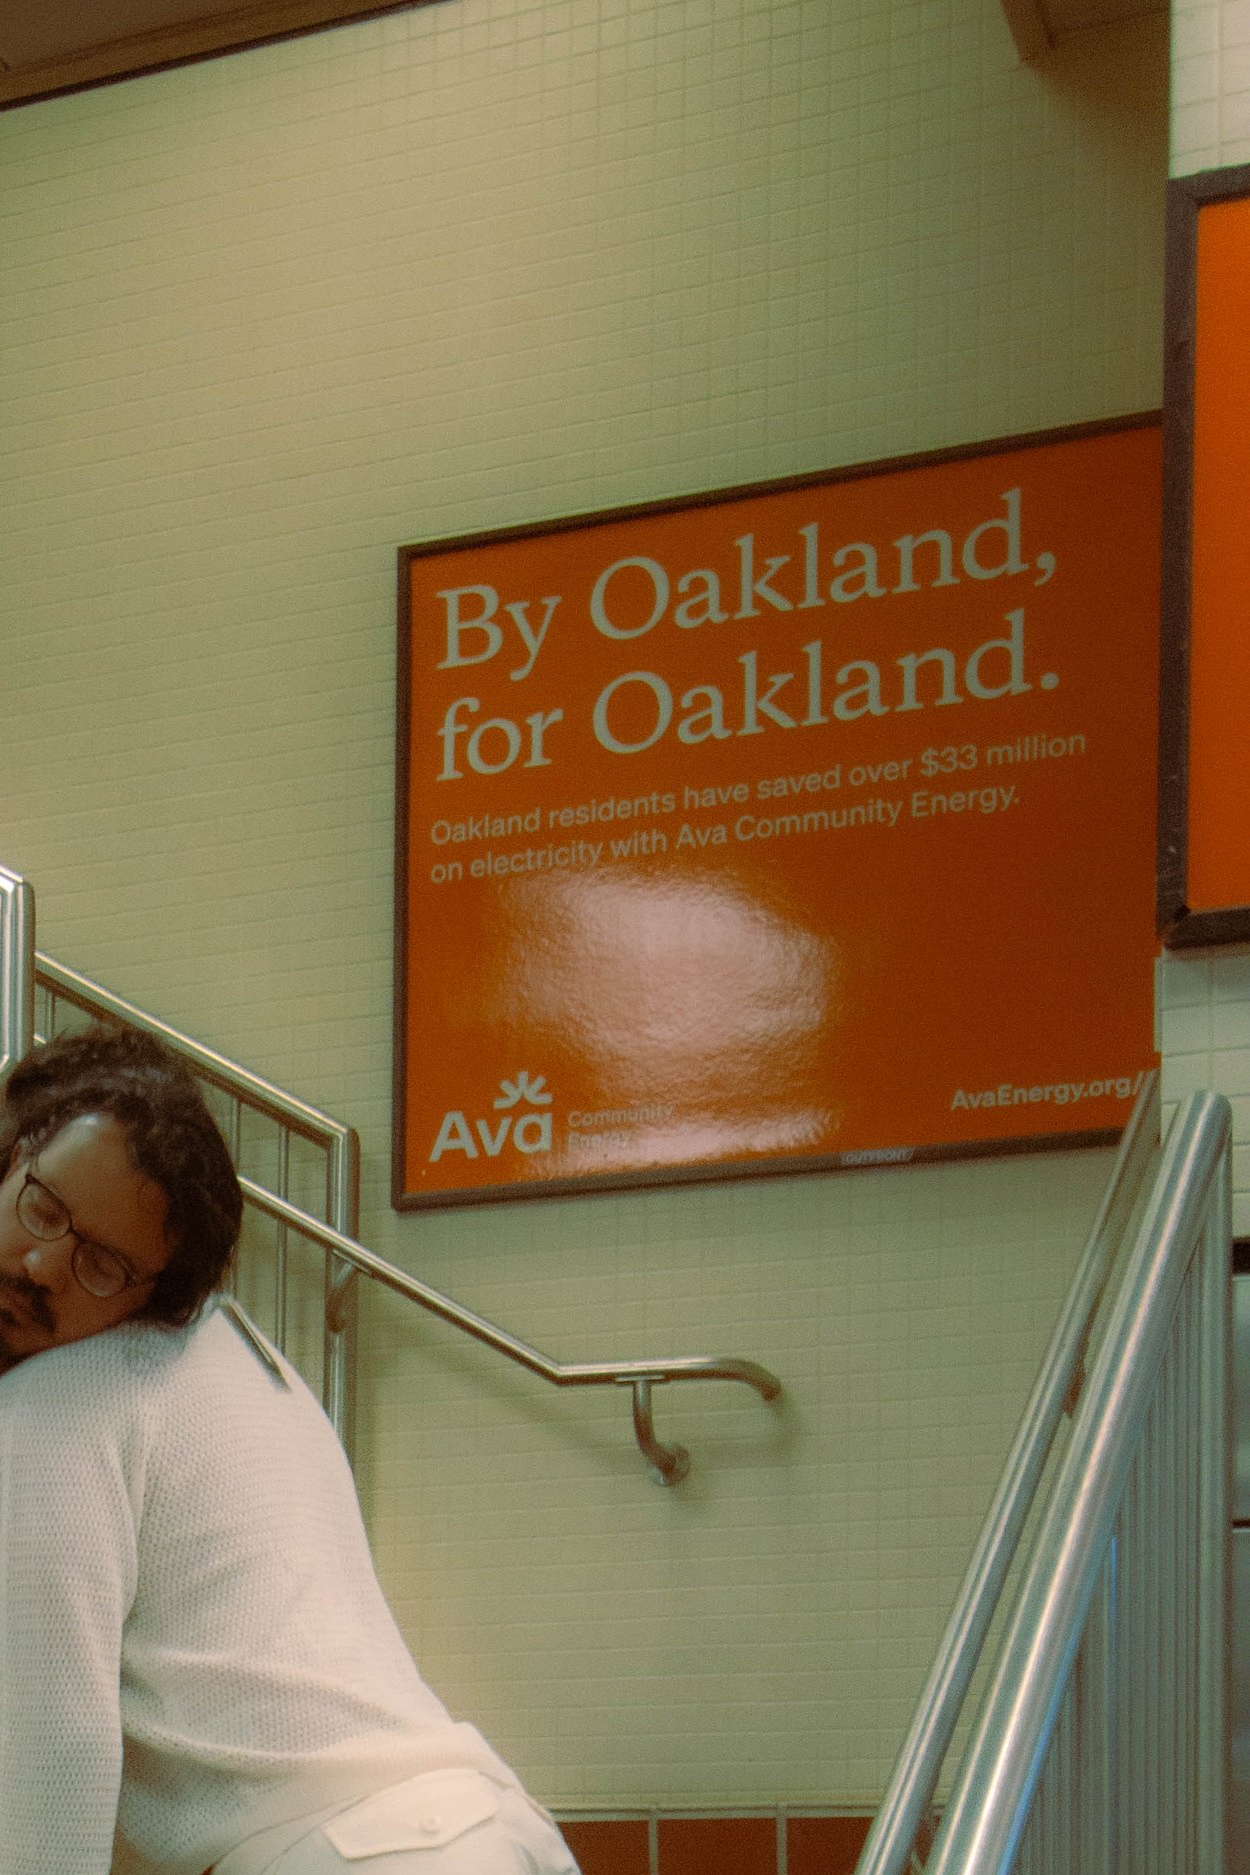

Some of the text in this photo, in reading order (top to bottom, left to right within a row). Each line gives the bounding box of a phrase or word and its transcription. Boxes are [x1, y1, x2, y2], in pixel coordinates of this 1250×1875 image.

[436, 488, 1058, 680] By Oakland,
[436, 608, 1059, 782] for Oakland.
[430, 731, 1086, 846] Oakland residents have saved over $33 million
[430, 783, 1022, 884] on electricity with Ava Community Energy.
[429, 1109, 553, 1163] Ava
